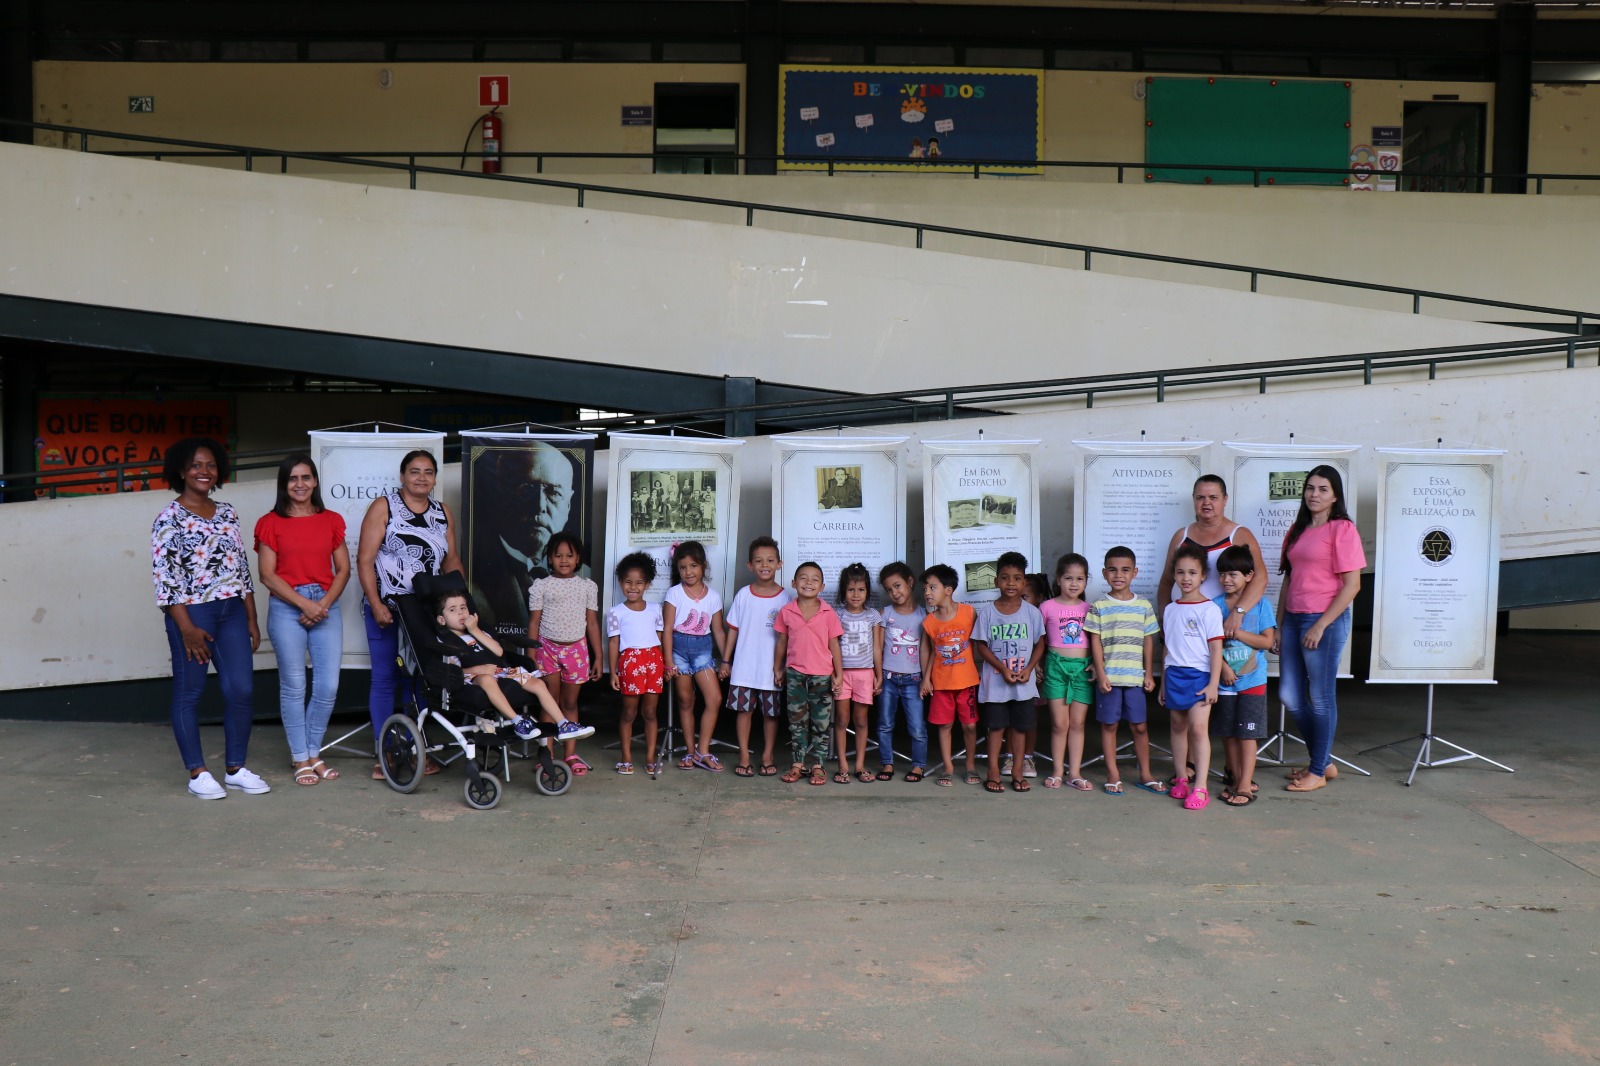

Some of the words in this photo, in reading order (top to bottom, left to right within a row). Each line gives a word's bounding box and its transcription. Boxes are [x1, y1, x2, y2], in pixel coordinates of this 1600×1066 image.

[46, 414, 100, 436] QUE
[109, 413, 166, 434] BOM
[175, 415, 223, 434] TER
[64, 440, 138, 466] VOCÊ
[964, 467, 977, 476] EM
[980, 467, 1001, 476] BOM
[1112, 468, 1173, 478] ATIVIDADES
[959, 477, 1007, 487] DESPACHO
[1429, 476, 1451, 486] ESSA
[330, 483, 401, 500] OLEGÁR
[1413, 486, 1466, 497] EXPOSIÇÃO
[1424, 496, 1429, 506] É
[1432, 498, 1454, 506] UMA
[1257, 508, 1265, 517] A
[1267, 509, 1298, 517] MORT
[1401, 506, 1459, 518] REALIZAÇÃO
[1462, 508, 1476, 517] DA
[813, 521, 865, 531] CARREIRA
[1260, 517, 1294, 527] PALÁC
[1262, 528, 1289, 537] LIBER
[494, 626, 529, 635] LEGÁRIO
[990, 623, 1029, 641] PIZZA
[1226, 647, 1249, 662] BEACH
